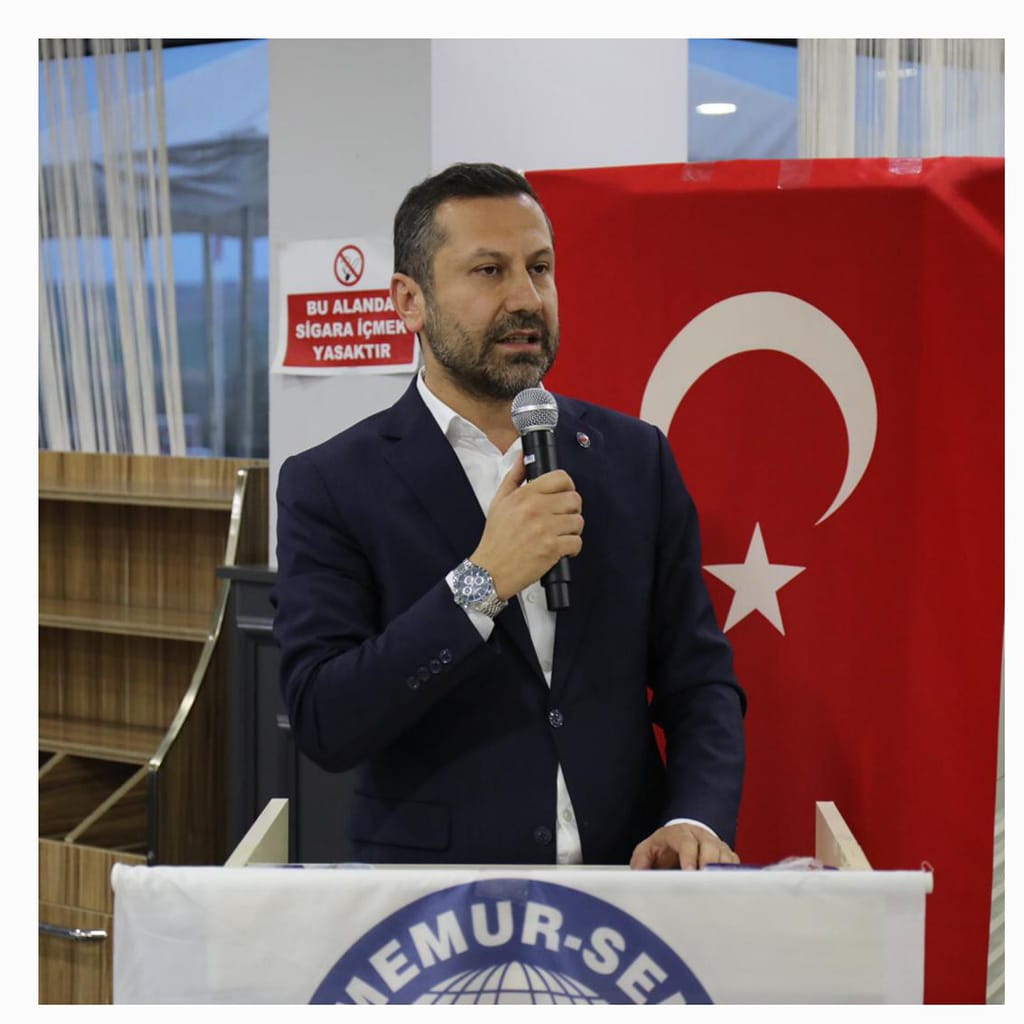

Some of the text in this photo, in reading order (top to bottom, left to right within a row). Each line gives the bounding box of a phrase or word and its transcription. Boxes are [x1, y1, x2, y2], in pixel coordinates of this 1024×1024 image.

[306, 297, 395, 316] BU ALANDA
[295, 318, 407, 340] SİGARA İÇMEK
[313, 343, 391, 361] YASAKTIR
